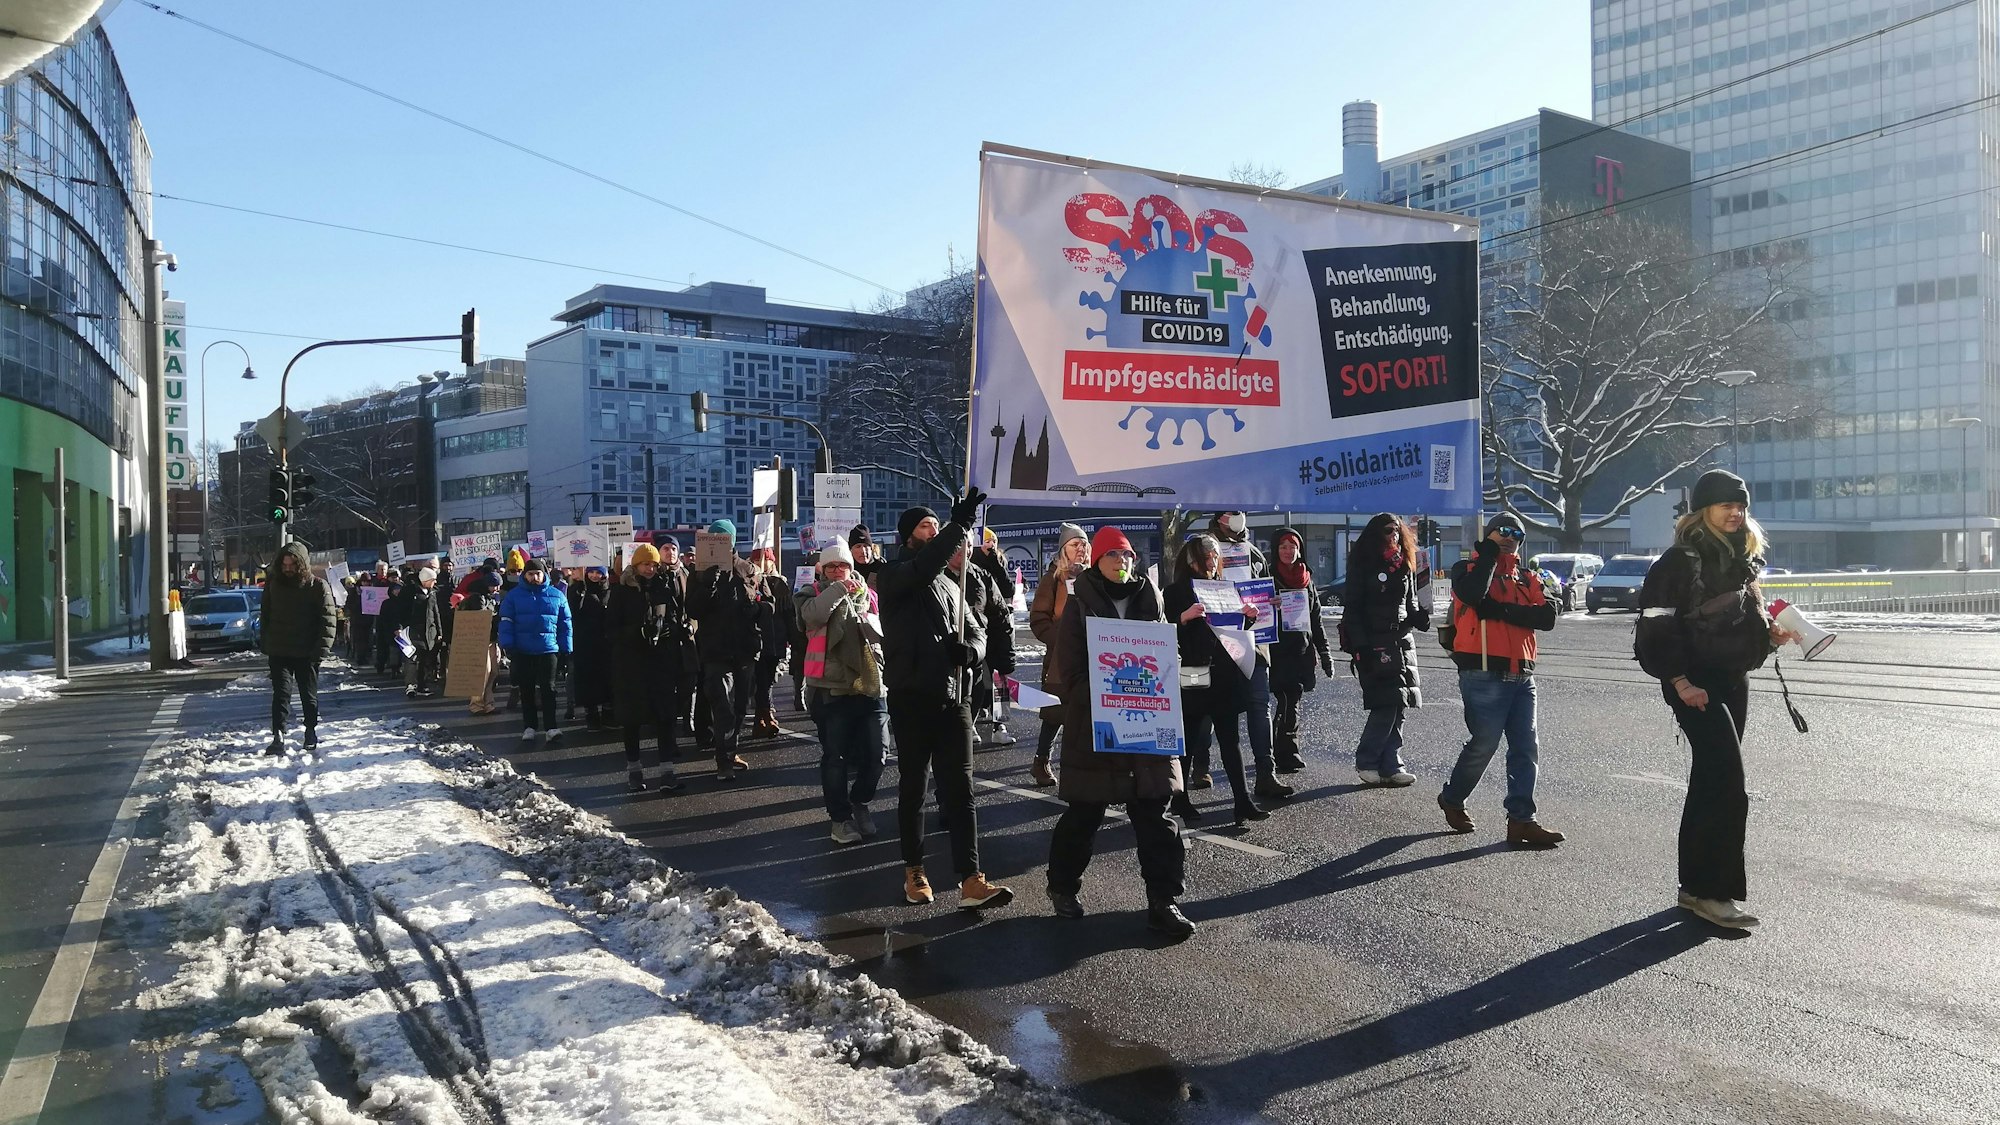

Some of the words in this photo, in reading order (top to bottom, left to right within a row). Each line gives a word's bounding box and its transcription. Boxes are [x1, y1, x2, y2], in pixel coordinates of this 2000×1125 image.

[1595, 155, 1625, 216] T
[1062, 193, 1255, 281] SOS
[1325, 264, 1437, 286] Anerkennung,
[1131, 295, 1171, 314] Hilfe
[1175, 298, 1201, 316] für
[1330, 293, 1431, 318] Behandlung,
[1150, 322, 1224, 343] COVID19
[1334, 324, 1452, 351] Entschädigung.
[1070, 362, 1274, 398] Impfgeschädigte
[1340, 355, 1448, 397] SOFORT!
[1299, 442, 1422, 485] #Solidarität
[826, 477, 850, 488] Geimpft
[1315, 482, 1353, 496] Selbsthilfe
[1354, 473, 1410, 489] Post-Vac-Syndrom
[1410, 470, 1424, 479] Köln
[832, 491, 850, 499] krank
[1035, 526, 1050, 535] KÖLN
[1007, 556, 1038, 571] ÖSSER
[1098, 634, 1109, 642] Im
[1110, 636, 1130, 644] Stich
[1131, 638, 1168, 647] gelassen.
[1098, 652, 1159, 674] SOS
[1104, 695, 1169, 710] Impfgeschädigte
[1122, 731, 1154, 739] #Solidarität
